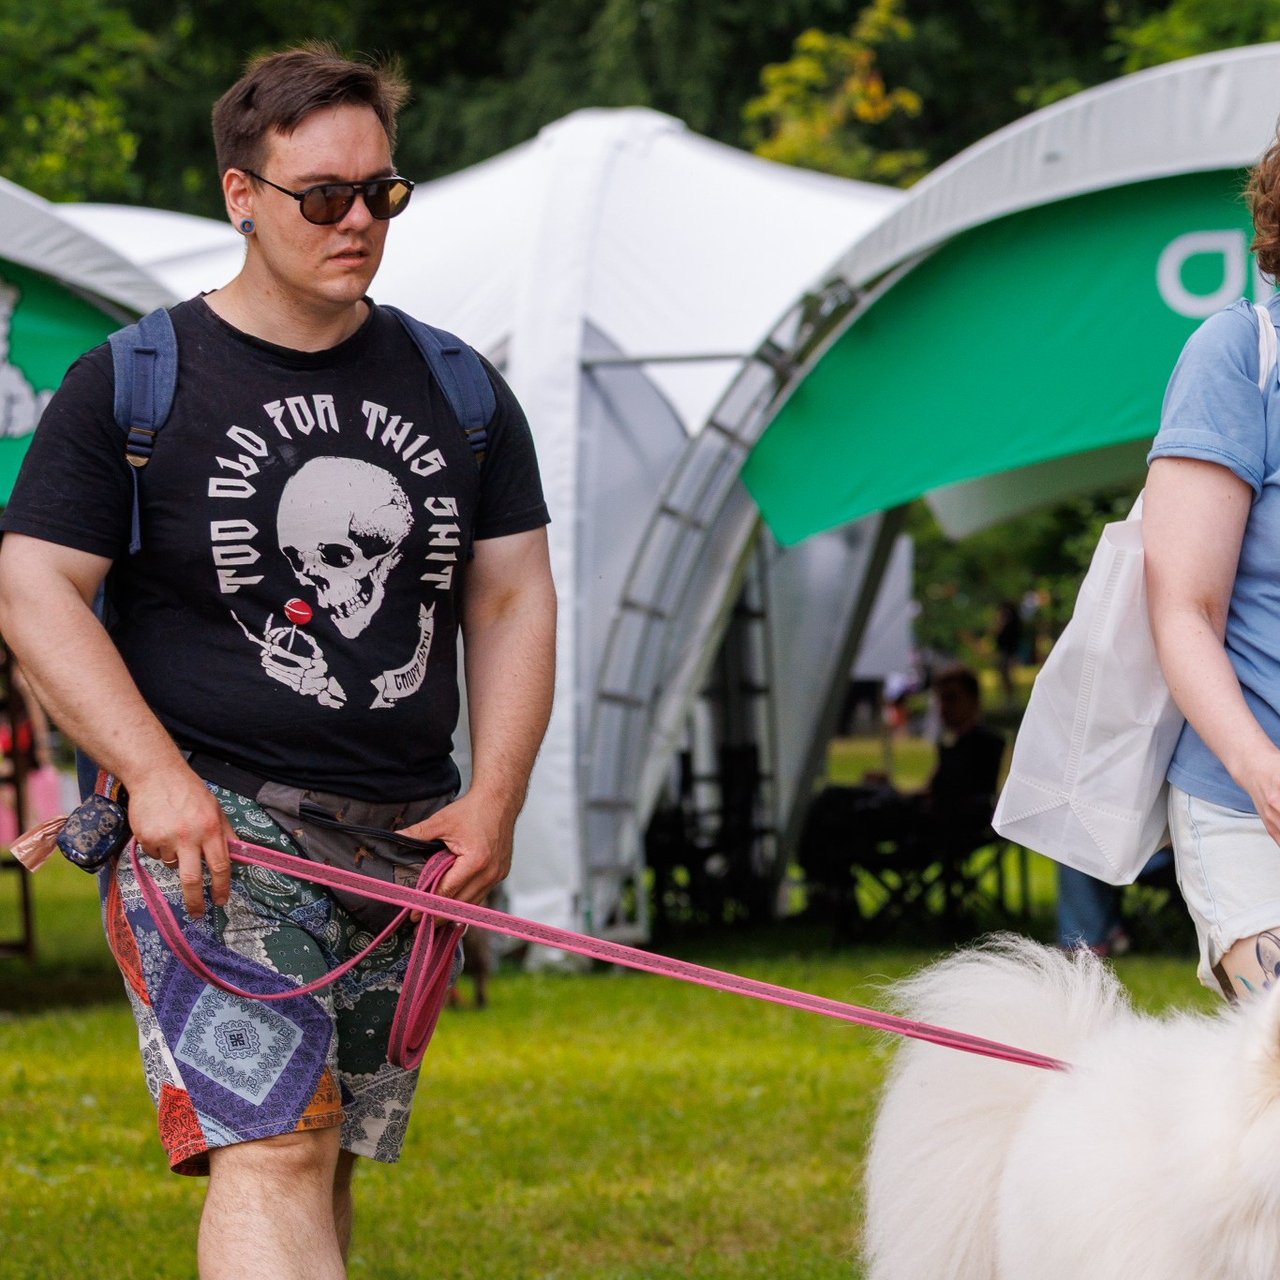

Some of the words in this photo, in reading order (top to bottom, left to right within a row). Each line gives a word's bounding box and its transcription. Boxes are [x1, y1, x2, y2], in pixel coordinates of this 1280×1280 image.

[263, 394, 340, 440] FOR
[361, 399, 448, 477] THIS
[207, 424, 269, 499] OLD
[210, 519, 265, 594] TOO
[420, 496, 462, 591] SHIT
